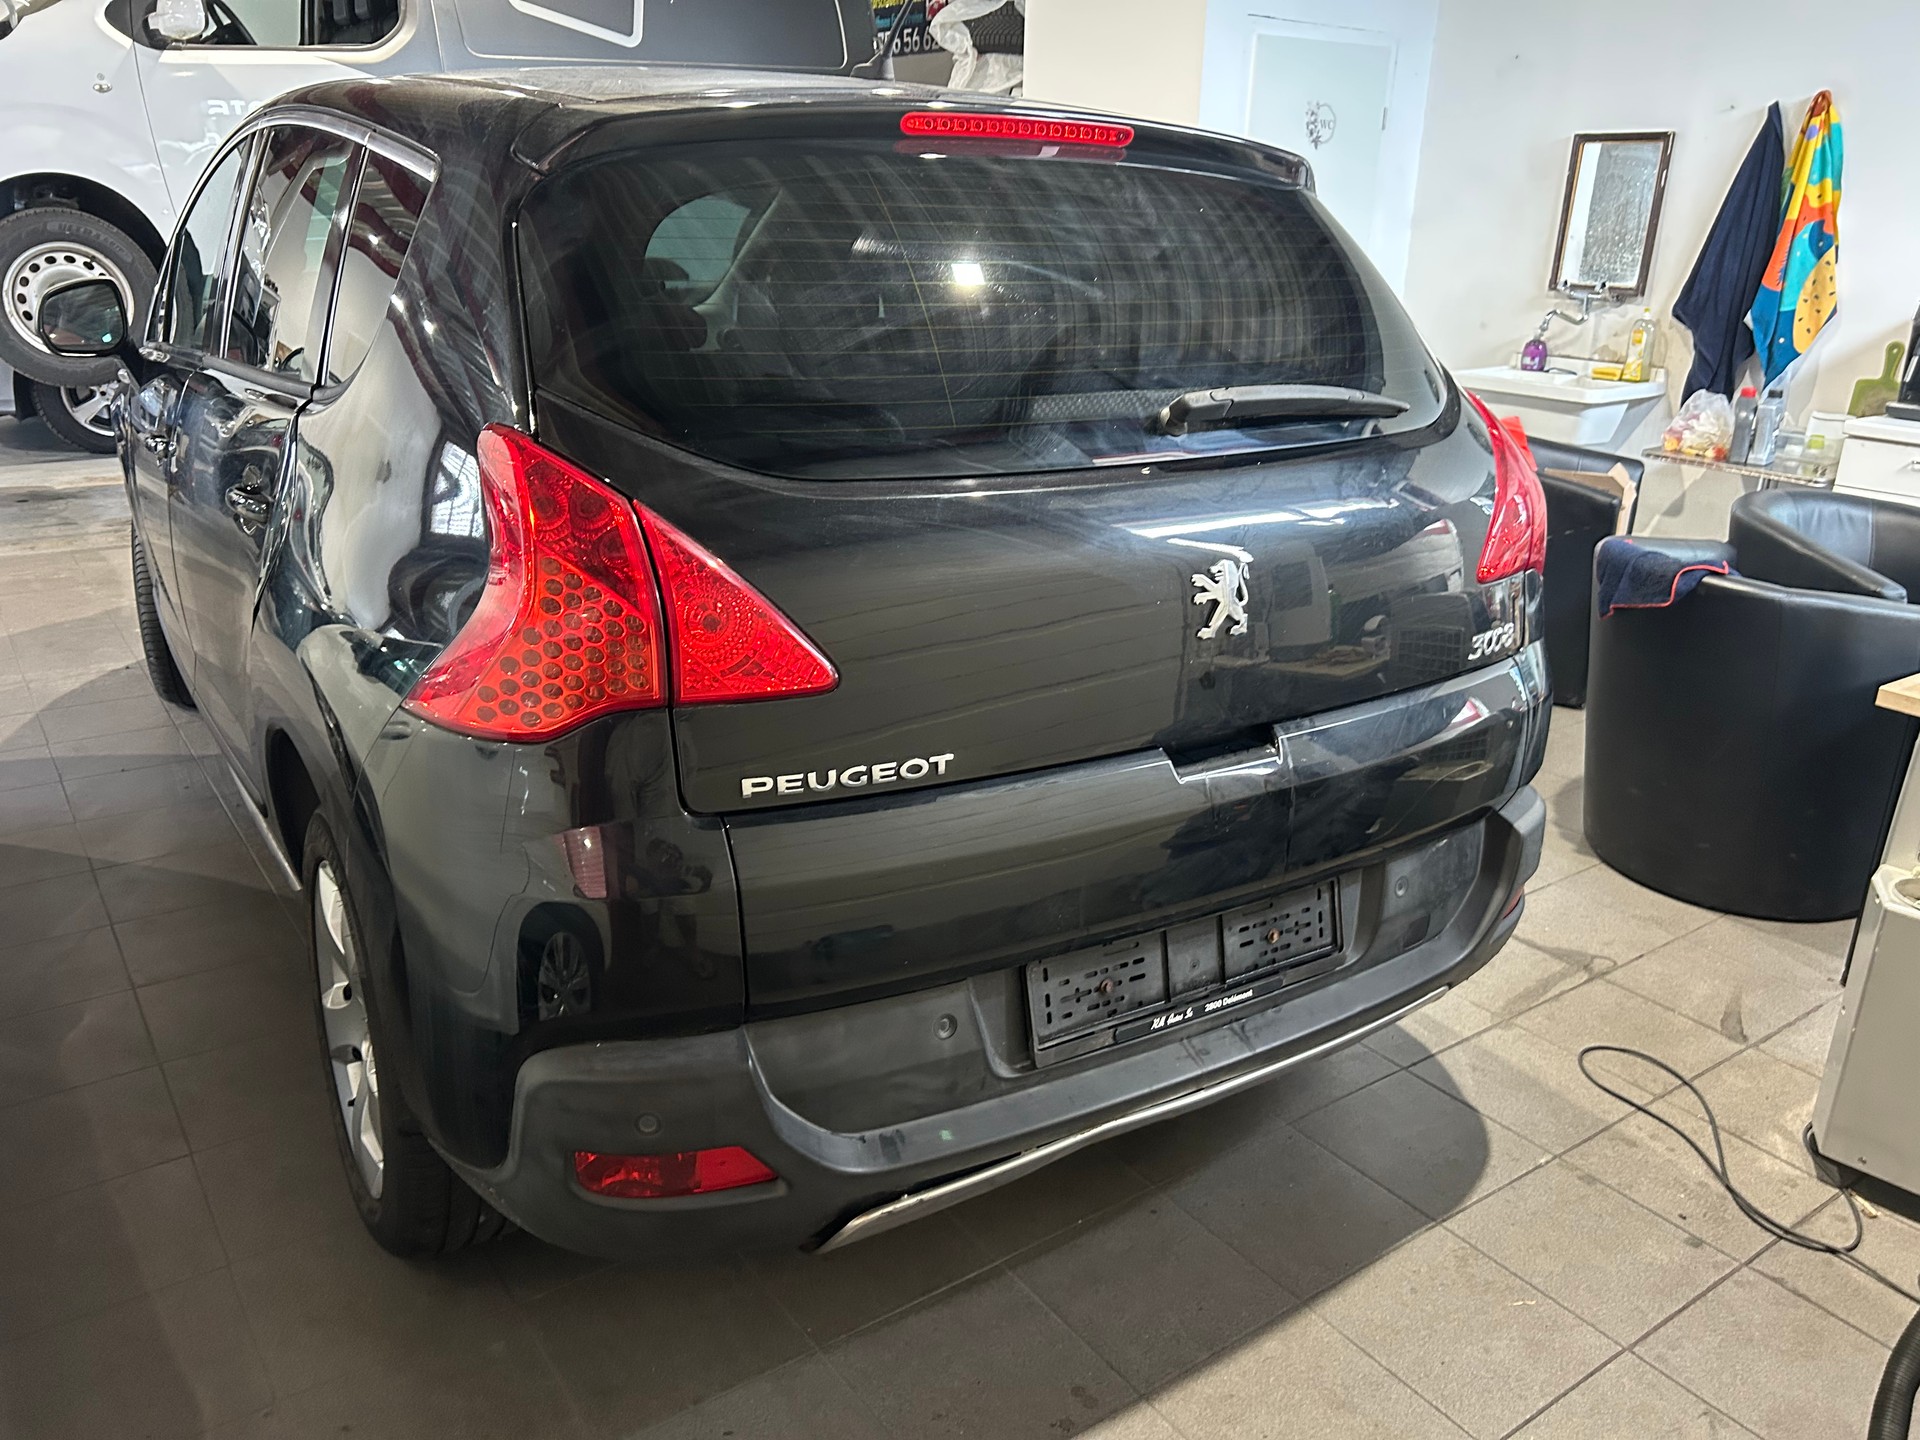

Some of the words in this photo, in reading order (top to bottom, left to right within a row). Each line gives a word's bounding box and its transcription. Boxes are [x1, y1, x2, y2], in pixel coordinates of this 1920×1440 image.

[903, 27, 920, 53] 56
[1319, 119, 1334, 130] WC
[1467, 622, 1515, 661] 3008
[741, 753, 955, 798] PEUGEOT
